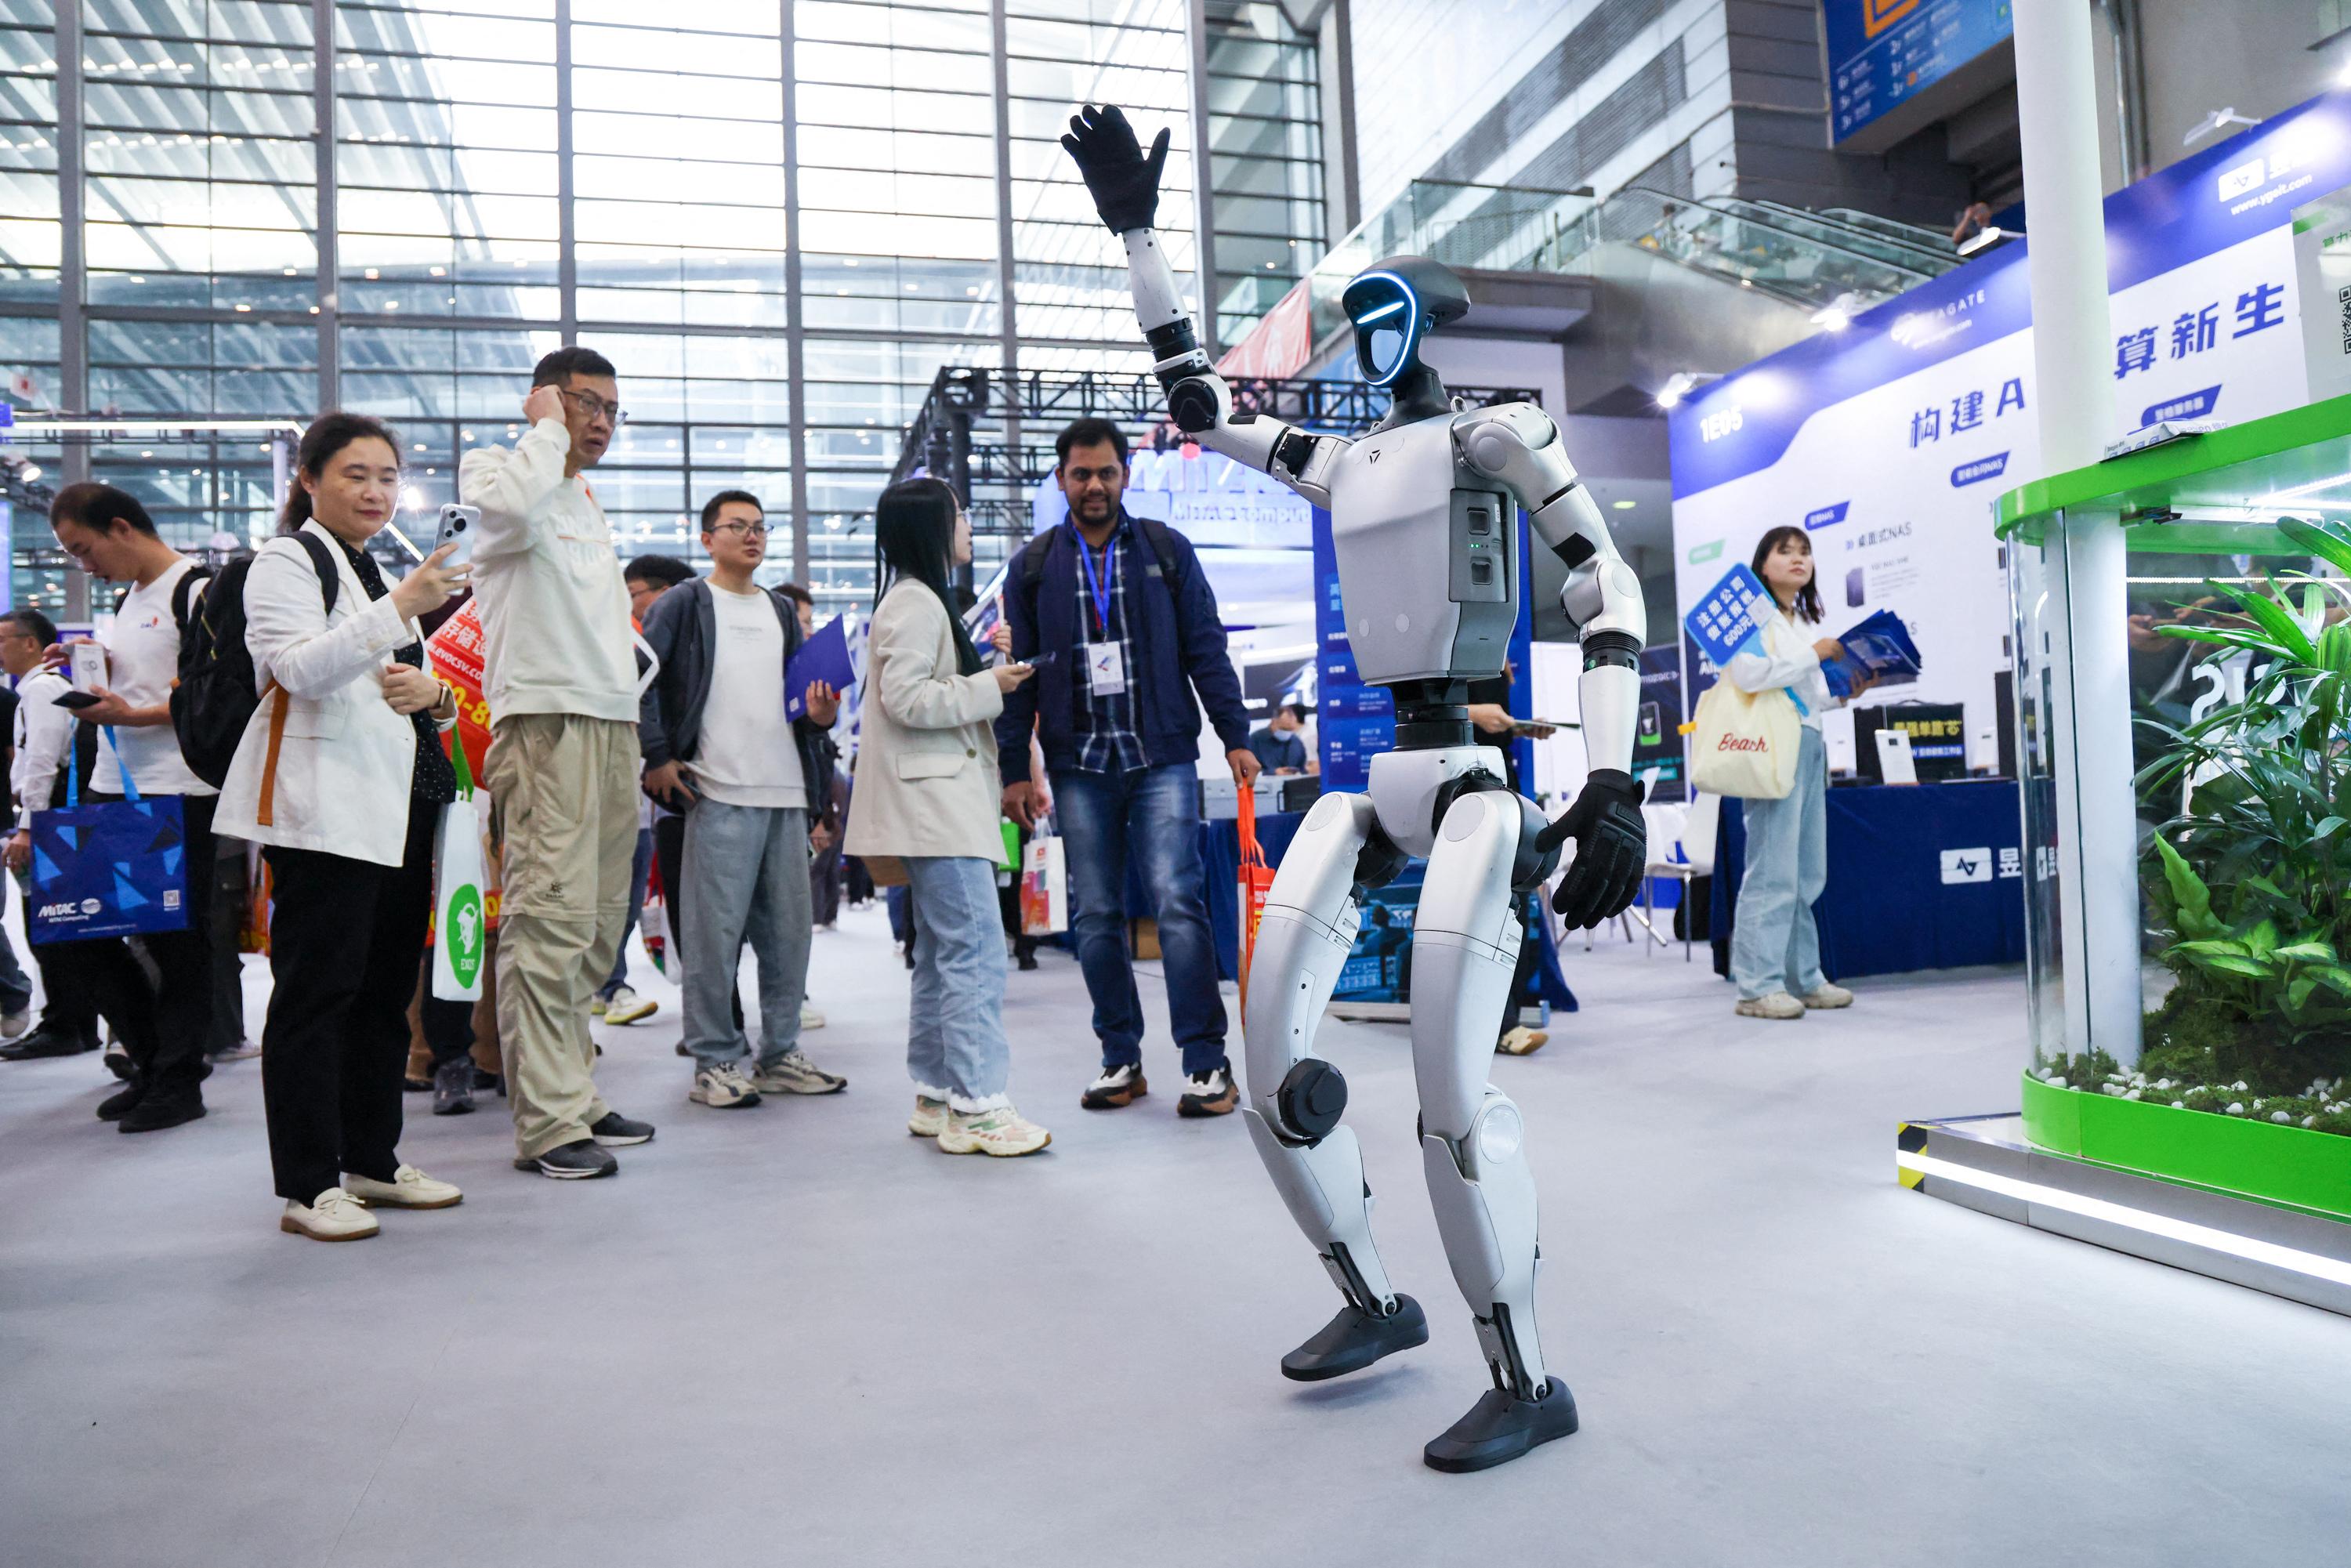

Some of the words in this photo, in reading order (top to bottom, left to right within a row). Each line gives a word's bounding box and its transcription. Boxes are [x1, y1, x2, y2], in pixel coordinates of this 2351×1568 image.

[2114, 283, 2284, 380] 算新生
[1696, 575, 1745, 628] 注册公司
[1718, 733, 1769, 753] Beach
[38, 903, 77, 918] MiTAC
